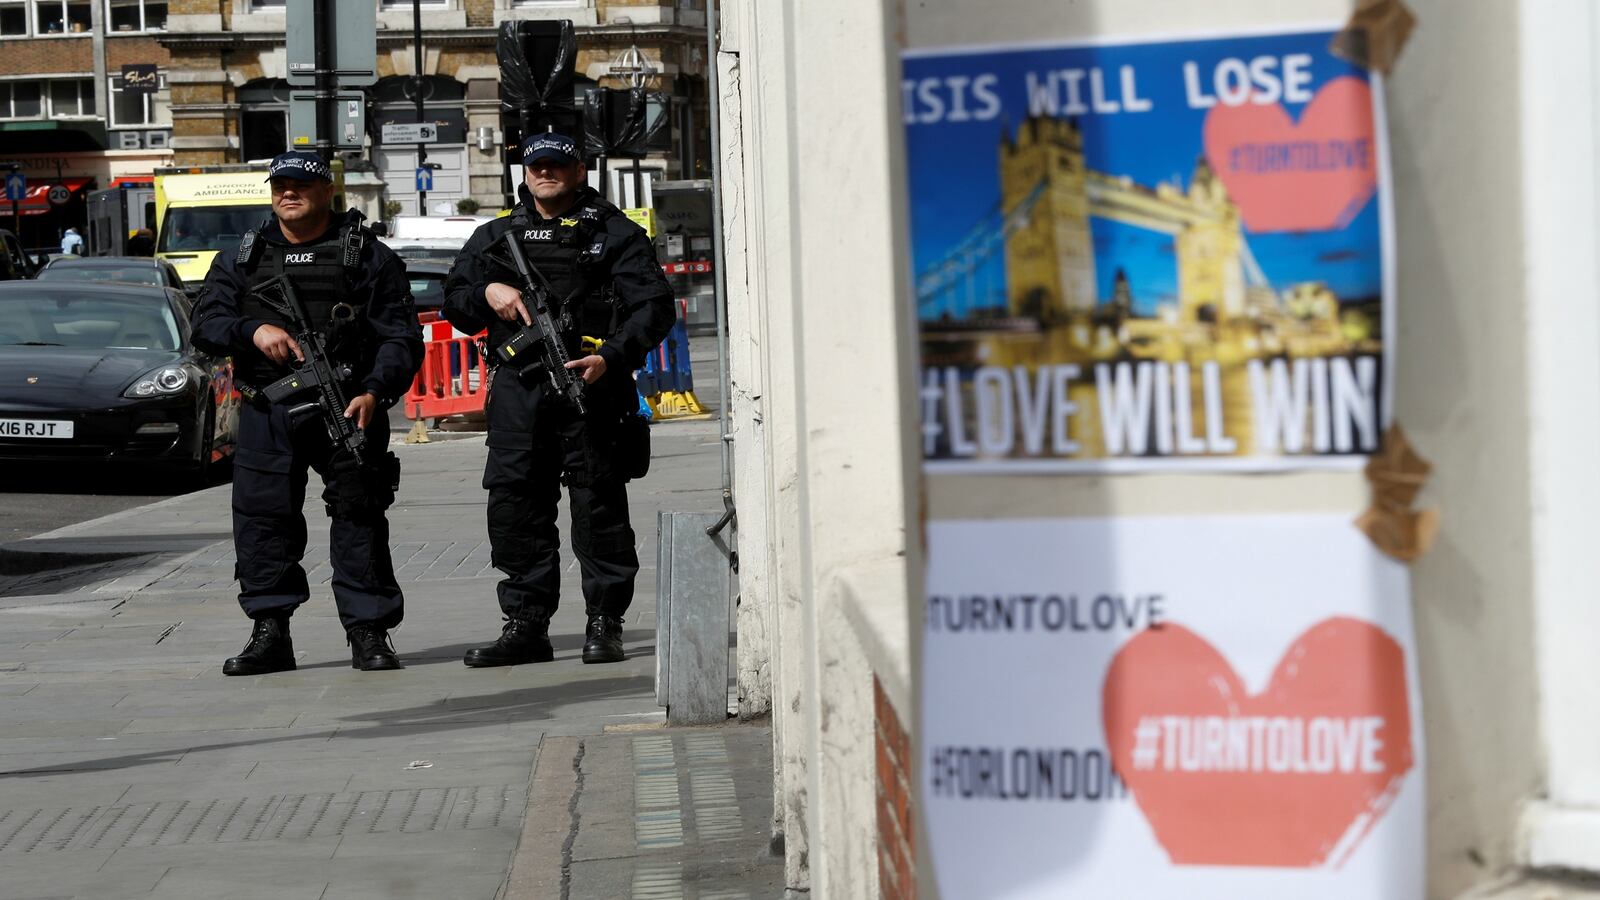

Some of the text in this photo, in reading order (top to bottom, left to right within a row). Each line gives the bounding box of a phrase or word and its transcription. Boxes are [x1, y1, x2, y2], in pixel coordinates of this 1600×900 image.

[902, 54, 1313, 125] ISIS WILL LOSE
[1228, 138, 1368, 175] #TURNTOLOVE
[51, 189, 68, 200] 20
[193, 188, 268, 197] AMBULANCE
[523, 229, 553, 240] POLICE
[284, 252, 314, 264] POLICE
[921, 355, 1378, 455] #LOVE WILL WIN
[25, 422, 56, 436] RJT
[1132, 715, 1385, 773] #TURNTOLOVE
